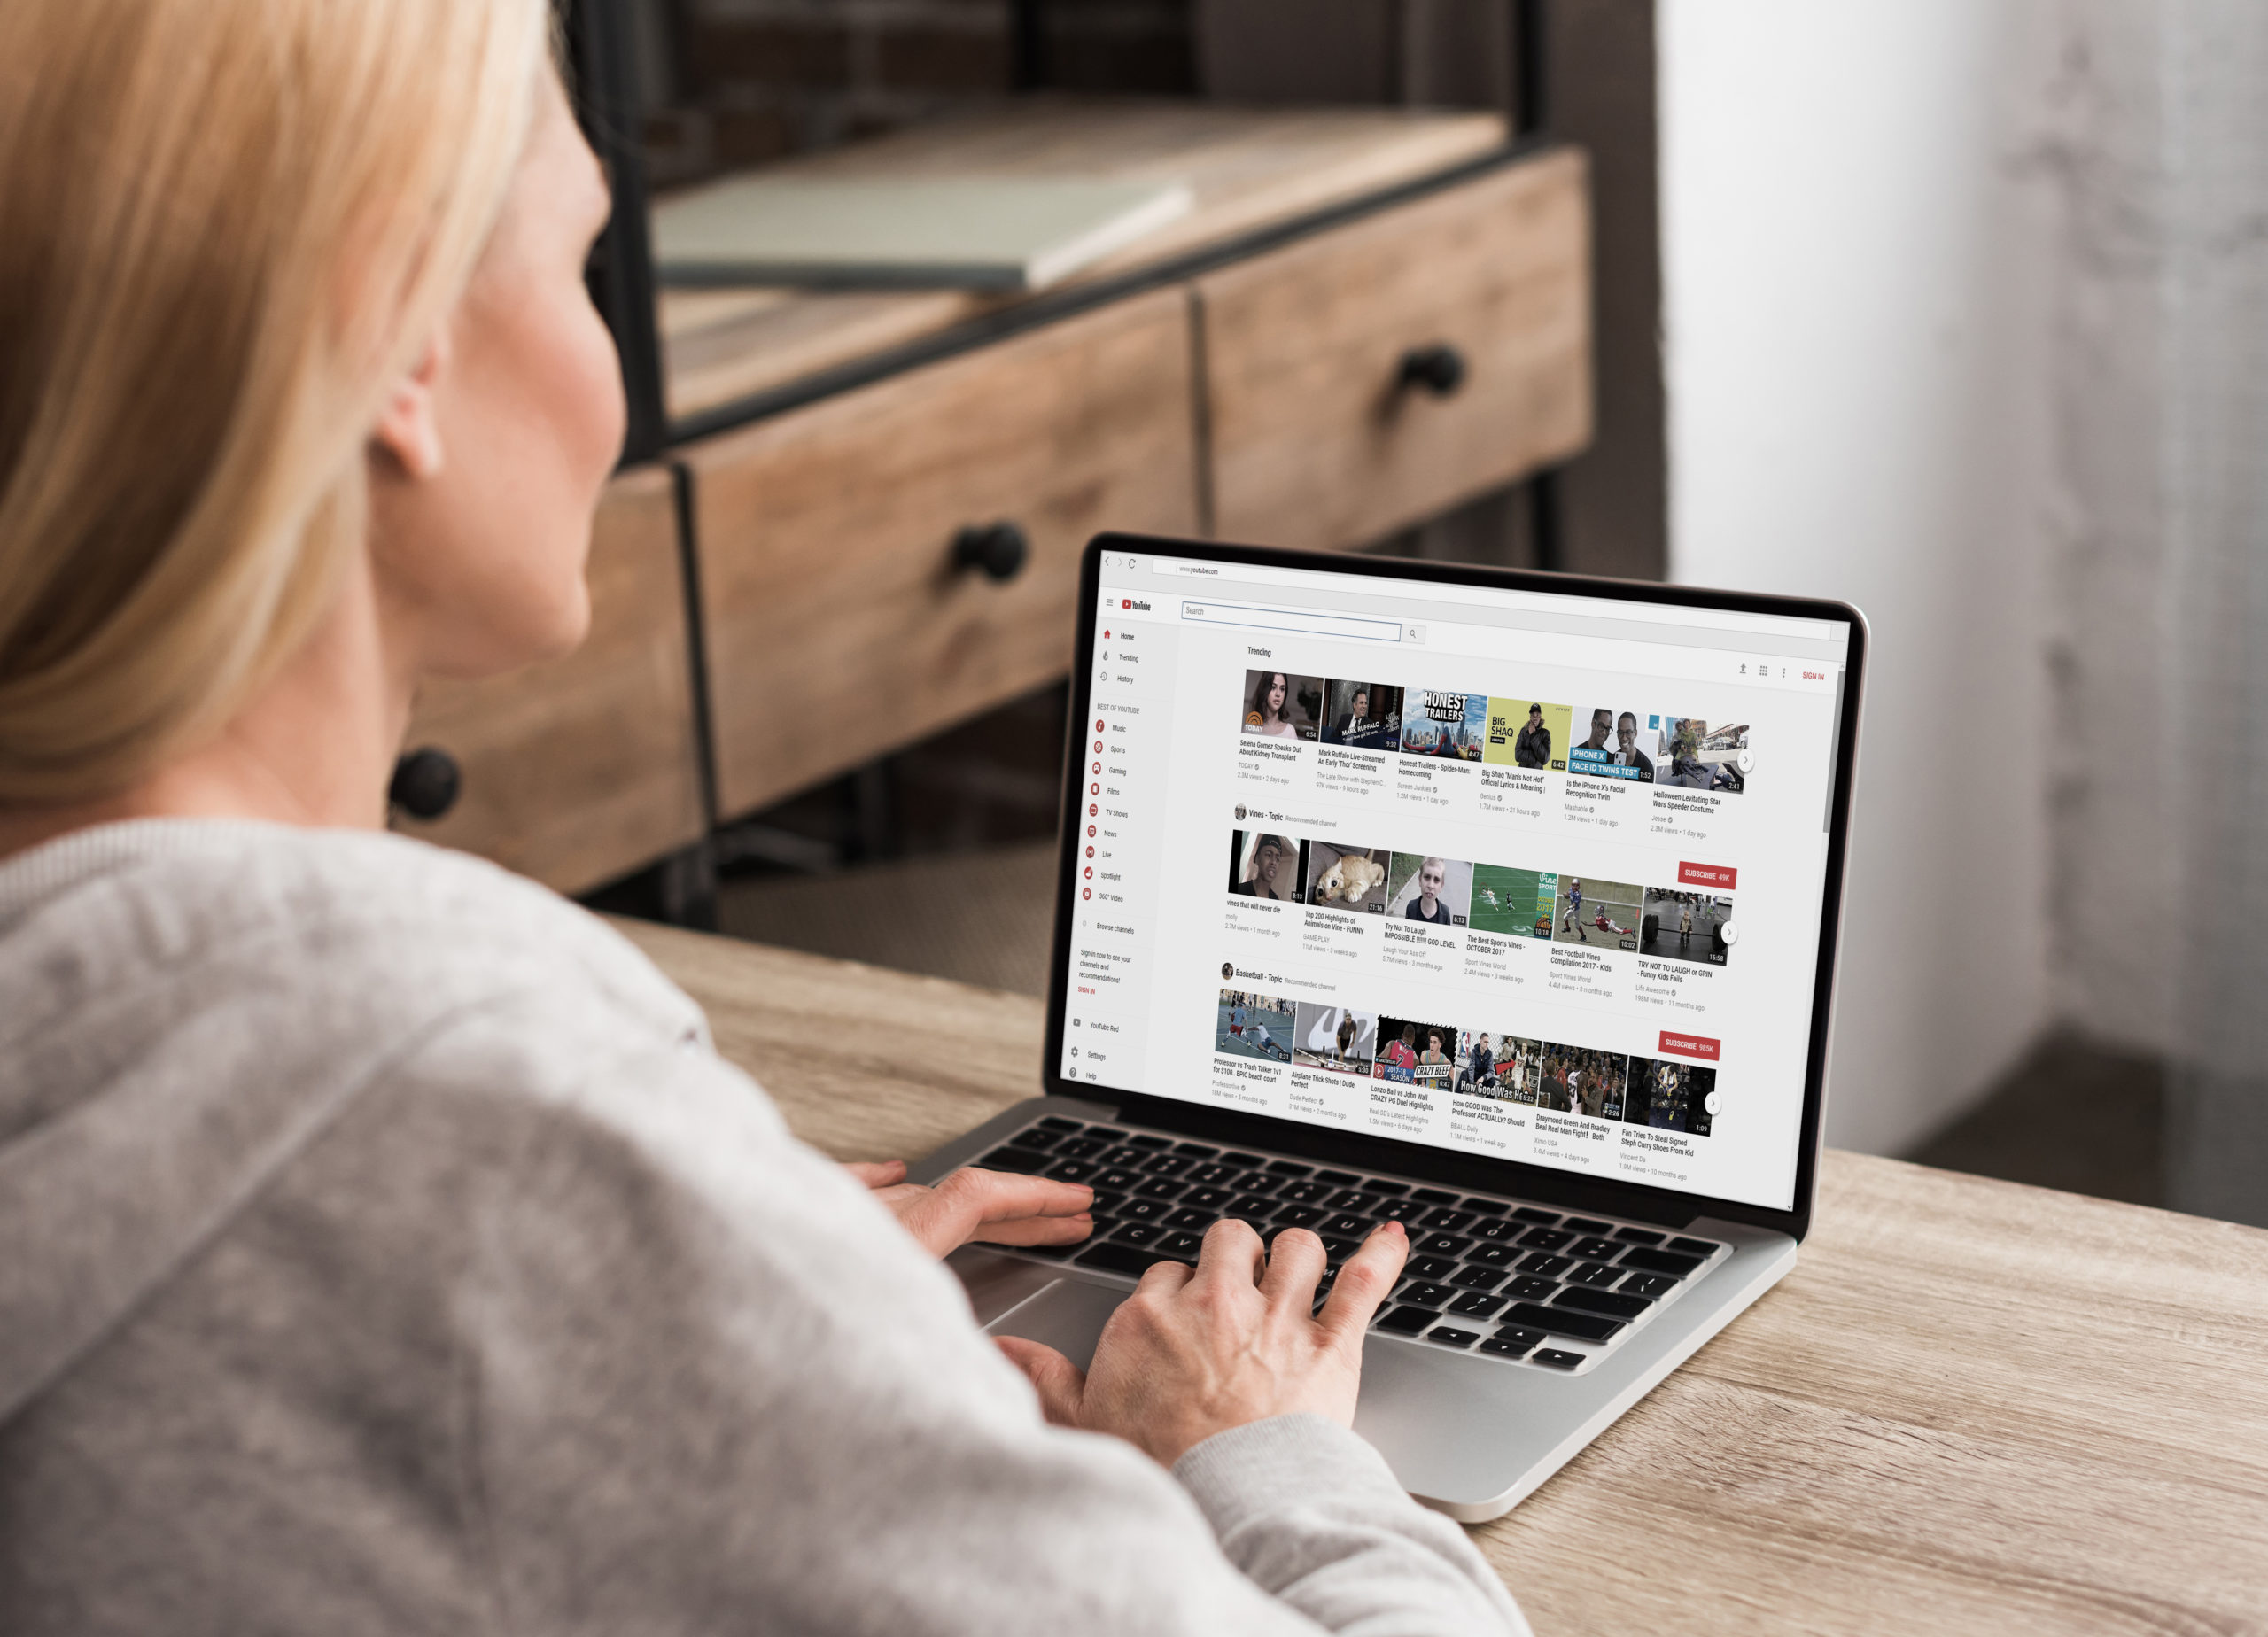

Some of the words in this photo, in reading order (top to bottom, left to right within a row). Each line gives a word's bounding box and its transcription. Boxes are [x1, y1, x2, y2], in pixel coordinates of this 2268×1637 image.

[1131, 600, 1152, 611] YouTube
[1185, 605, 1205, 616] Search
[1247, 646, 1272, 658] Trending
[1119, 653, 1139, 664] Trending
[1116, 675, 1134, 685] History
[1802, 671, 1817, 680] SIGN
[1424, 691, 1467, 710] HONEST
[1117, 705, 1140, 715] YOUTUBE
[1425, 707, 1464, 721] TRAILERS
[1492, 716, 1505, 725] BIG
[1112, 724, 1127, 733] Music
[1491, 725, 1513, 736] SHAQ
[1110, 745, 1126, 754] Sports
[1239, 739, 1256, 748] Selena
[1256, 741, 1274, 750] Gomez
[1273, 743, 1292, 752] Speaks
[1239, 748, 1254, 756] About
[1254, 749, 1270, 759] Kidney
[1270, 751, 1296, 762] Transplant
[1318, 749, 1332, 757] Mark
[1331, 750, 1350, 759] Ruffalo
[1349, 753, 1386, 764] Live-Streamed
[1572, 749, 1597, 759] IPHONE
[1108, 766, 1127, 777] Gaming
[1324, 758, 1338, 768] Early
[1352, 762, 1377, 773] Screening
[1571, 762, 1588, 771] FACE
[1598, 764, 1619, 774] TWINS
[1620, 767, 1637, 776] TEST
[1398, 767, 1432, 780] Homecoming
[1481, 769, 1491, 779] Big
[1490, 770, 1505, 780] Shaq
[1504, 772, 1522, 781] "Man's
[1532, 775, 1545, 784] Hot"
[1107, 787, 1120, 795] Films
[1572, 780, 1581, 788] the
[1581, 781, 1601, 791] iPhone
[1609, 784, 1626, 794] Facial
[1480, 792, 1496, 801] Genius
[1565, 788, 1597, 799] Recognition
[1597, 792, 1611, 801] Twin
[1653, 790, 1682, 801] Halloween
[1682, 794, 1709, 806] Levitating
[1564, 803, 1588, 813] Mashable
[1652, 799, 1666, 808] Wars
[1666, 801, 1689, 811] Speeder
[1689, 803, 1715, 814] Costume
[1112, 809, 1129, 818] Shows
[1248, 809, 1264, 818] Vines
[1268, 811, 1284, 822] Topic
[1103, 829, 1117, 838] News
[1100, 871, 1122, 882] Spotlight
[1684, 868, 1717, 880] SUBSCRIBE
[1099, 892, 1110, 901] 360°
[1110, 894, 1123, 903] Video
[1305, 910, 1315, 919] Top
[1314, 912, 1324, 920] 200
[1324, 913, 1350, 925] Highlights
[1096, 922, 1114, 932] Browse
[1114, 925, 1135, 935] channels
[1385, 922, 1394, 932] Try
[1410, 927, 1426, 936] Laugh
[1080, 949, 1091, 958] Sign
[1466, 943, 1492, 954] OCTOBER
[1491, 947, 1505, 956] 2017
[1550, 947, 1564, 956] Best
[1564, 949, 1586, 959] Football
[1586, 952, 1601, 962] Vines
[1079, 960, 1100, 969] channels
[1637, 959, 1650, 968] TRY
[1671, 966, 1691, 975] LAUGH
[1697, 969, 1713, 978] GRIN
[1078, 971, 1121, 984] recommendations!
[1235, 967, 1264, 980] Basketball
[1267, 973, 1283, 984] Topic
[1077, 985, 1090, 994] SIGN
[1090, 1021, 1110, 1031] YouTube
[1109, 1024, 1120, 1033] Red
[1665, 1038, 1697, 1051] SUBSCRIBE
[1698, 1043, 1713, 1052] 985K
[1087, 1051, 1107, 1062] Settings
[1085, 1072, 1097, 1081] Help
[1387, 1066, 1406, 1075] 2017-18
[1416, 1066, 1432, 1075] CRAZY
[1434, 1066, 1449, 1075] BEEF
[1390, 1073, 1410, 1082] SEASON
[1370, 1093, 1388, 1103] CRAZY
[1396, 1098, 1409, 1106] Duel
[1408, 1100, 1433, 1111] Highlights
[1464, 1101, 1480, 1111] GOOD
[1480, 1104, 1492, 1113] Was
[1493, 1106, 1503, 1114] The
[1621, 1128, 1632, 1137] Fan
[1633, 1130, 1646, 1139] Tries
[1647, 1132, 1654, 1141] To
[1654, 1134, 1669, 1144] Steal
[1668, 1137, 1688, 1147] Signed
[1620, 1137, 1637, 1148] Steph
[1637, 1140, 1652, 1152] Curry
[1652, 1143, 1669, 1152] Shoes
[1669, 1145, 1684, 1155] From
